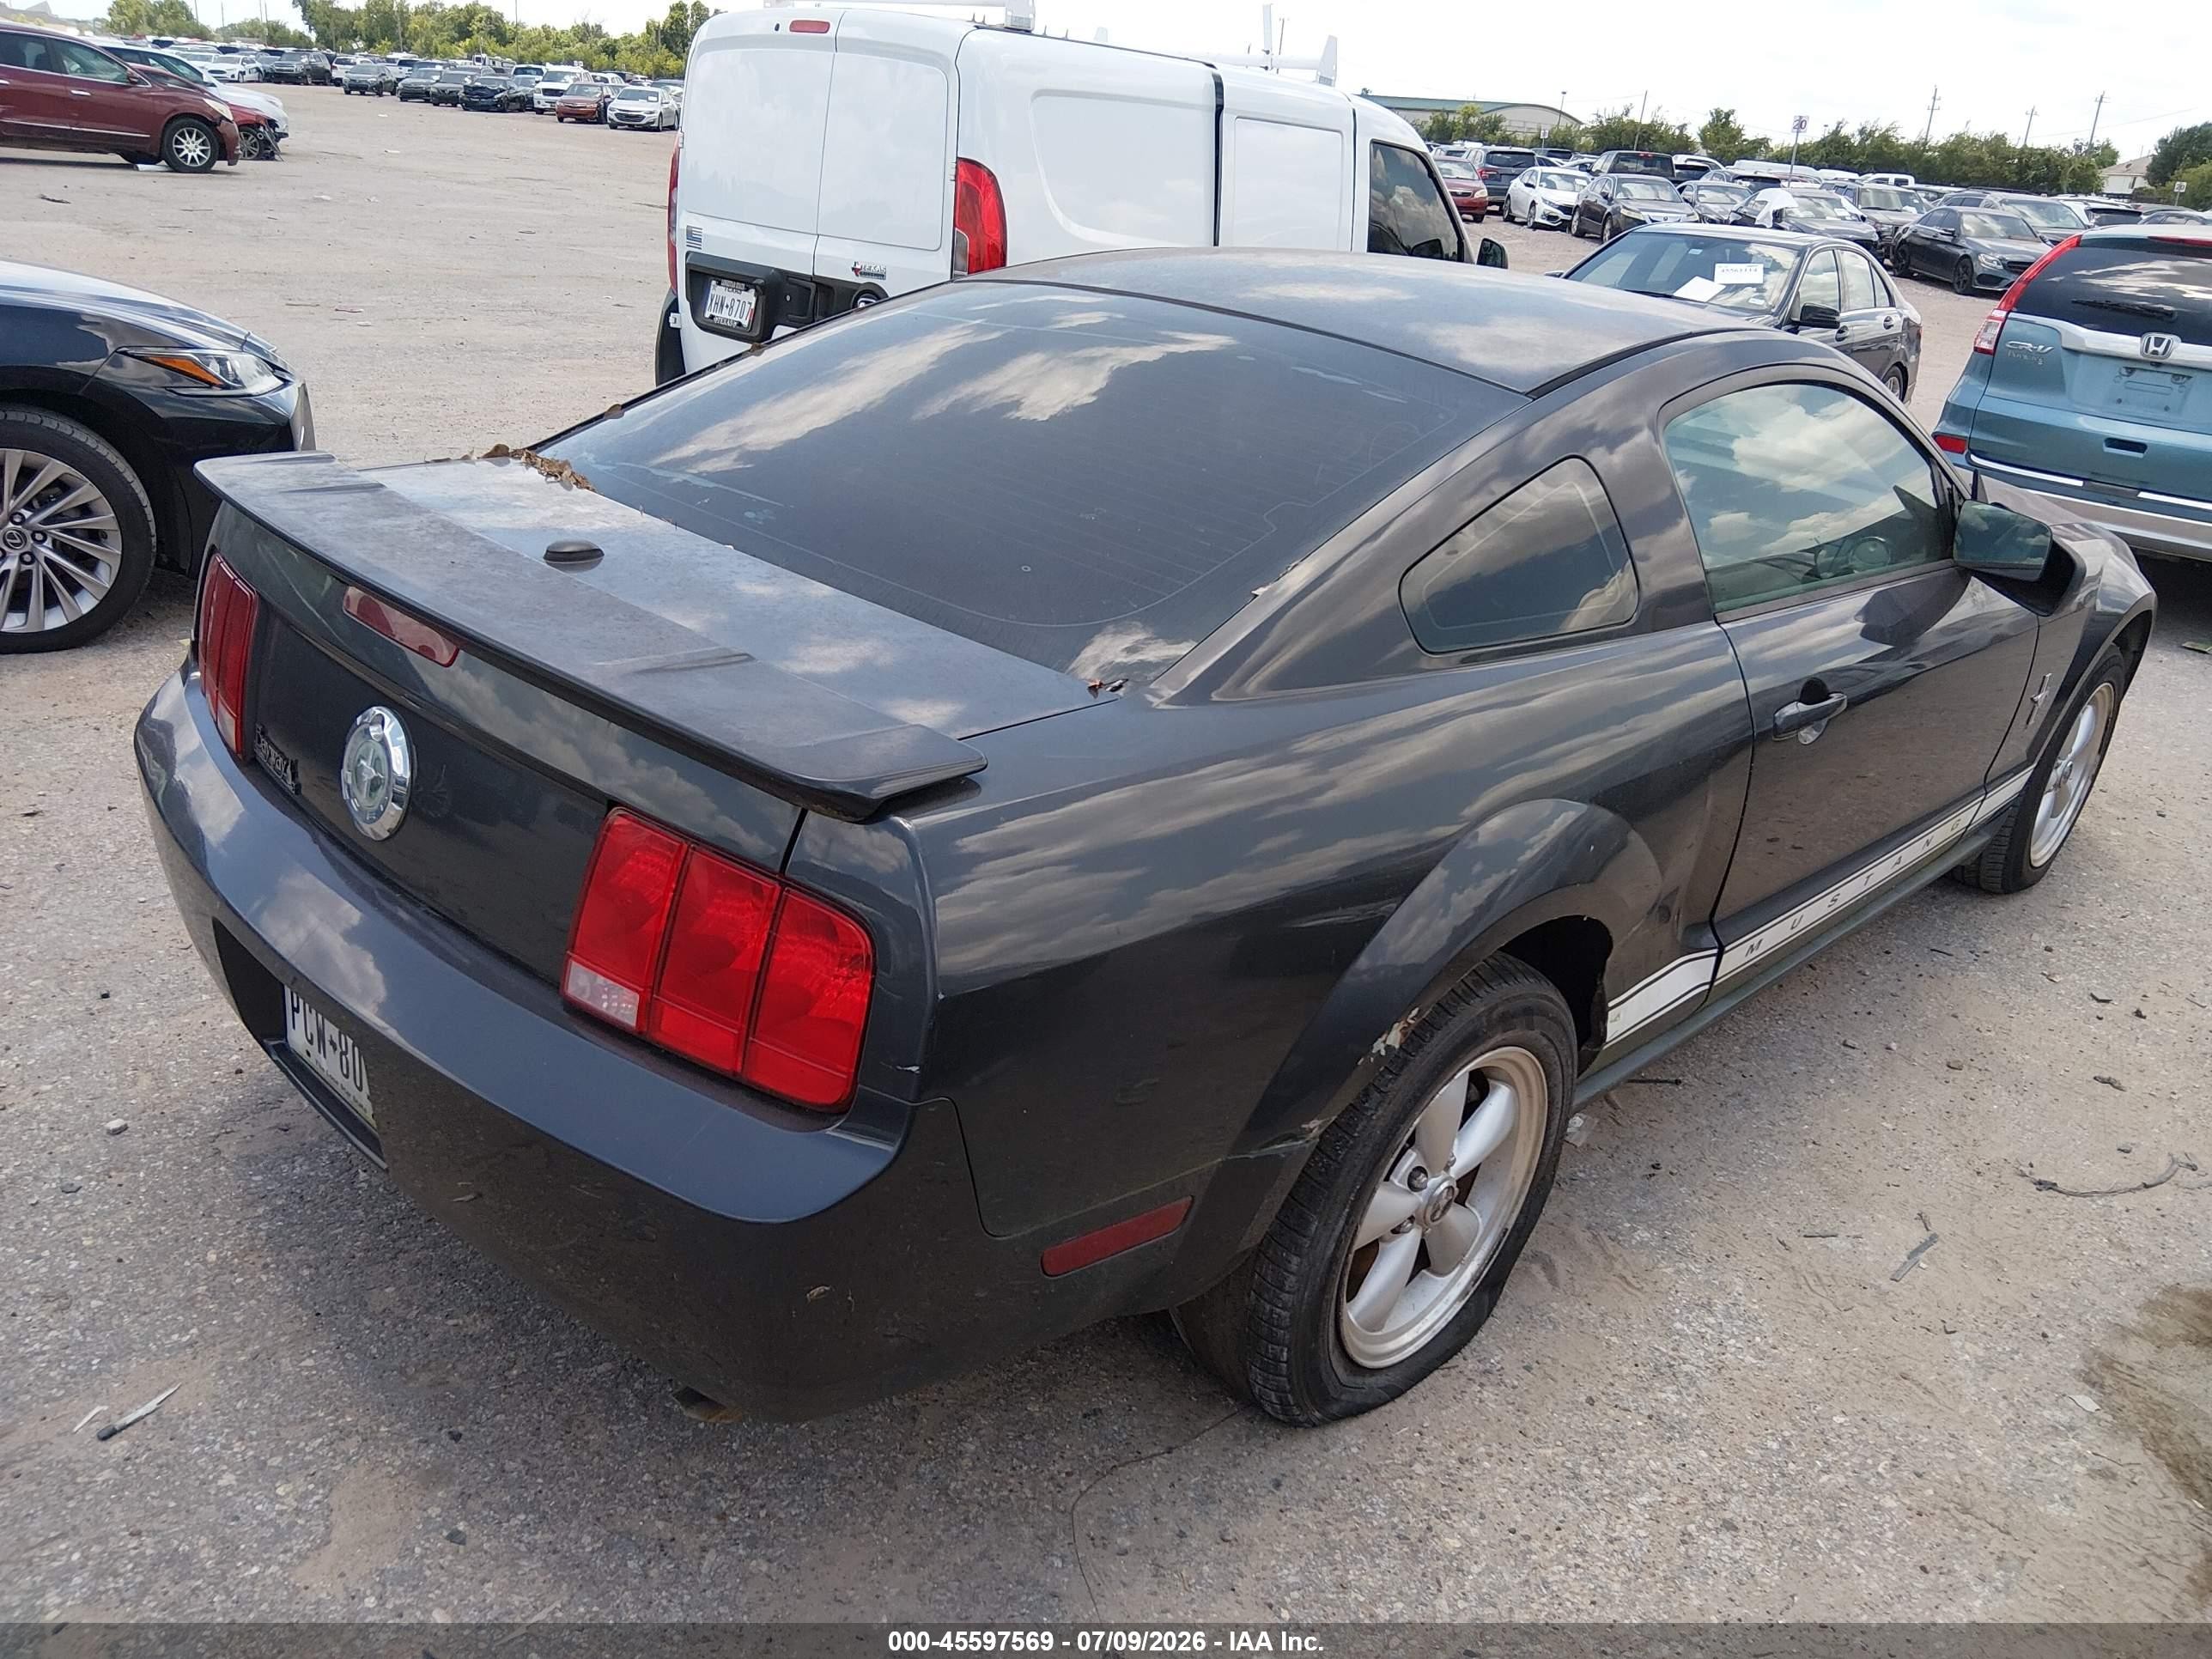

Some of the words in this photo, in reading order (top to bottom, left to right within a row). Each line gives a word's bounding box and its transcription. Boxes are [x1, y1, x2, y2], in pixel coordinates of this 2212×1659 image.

[1793, 118, 1807, 130] 20
[861, 263, 886, 274] TEXAS
[2006, 341, 2055, 354] CR-V
[1745, 818, 1961, 958] MUSTANG
